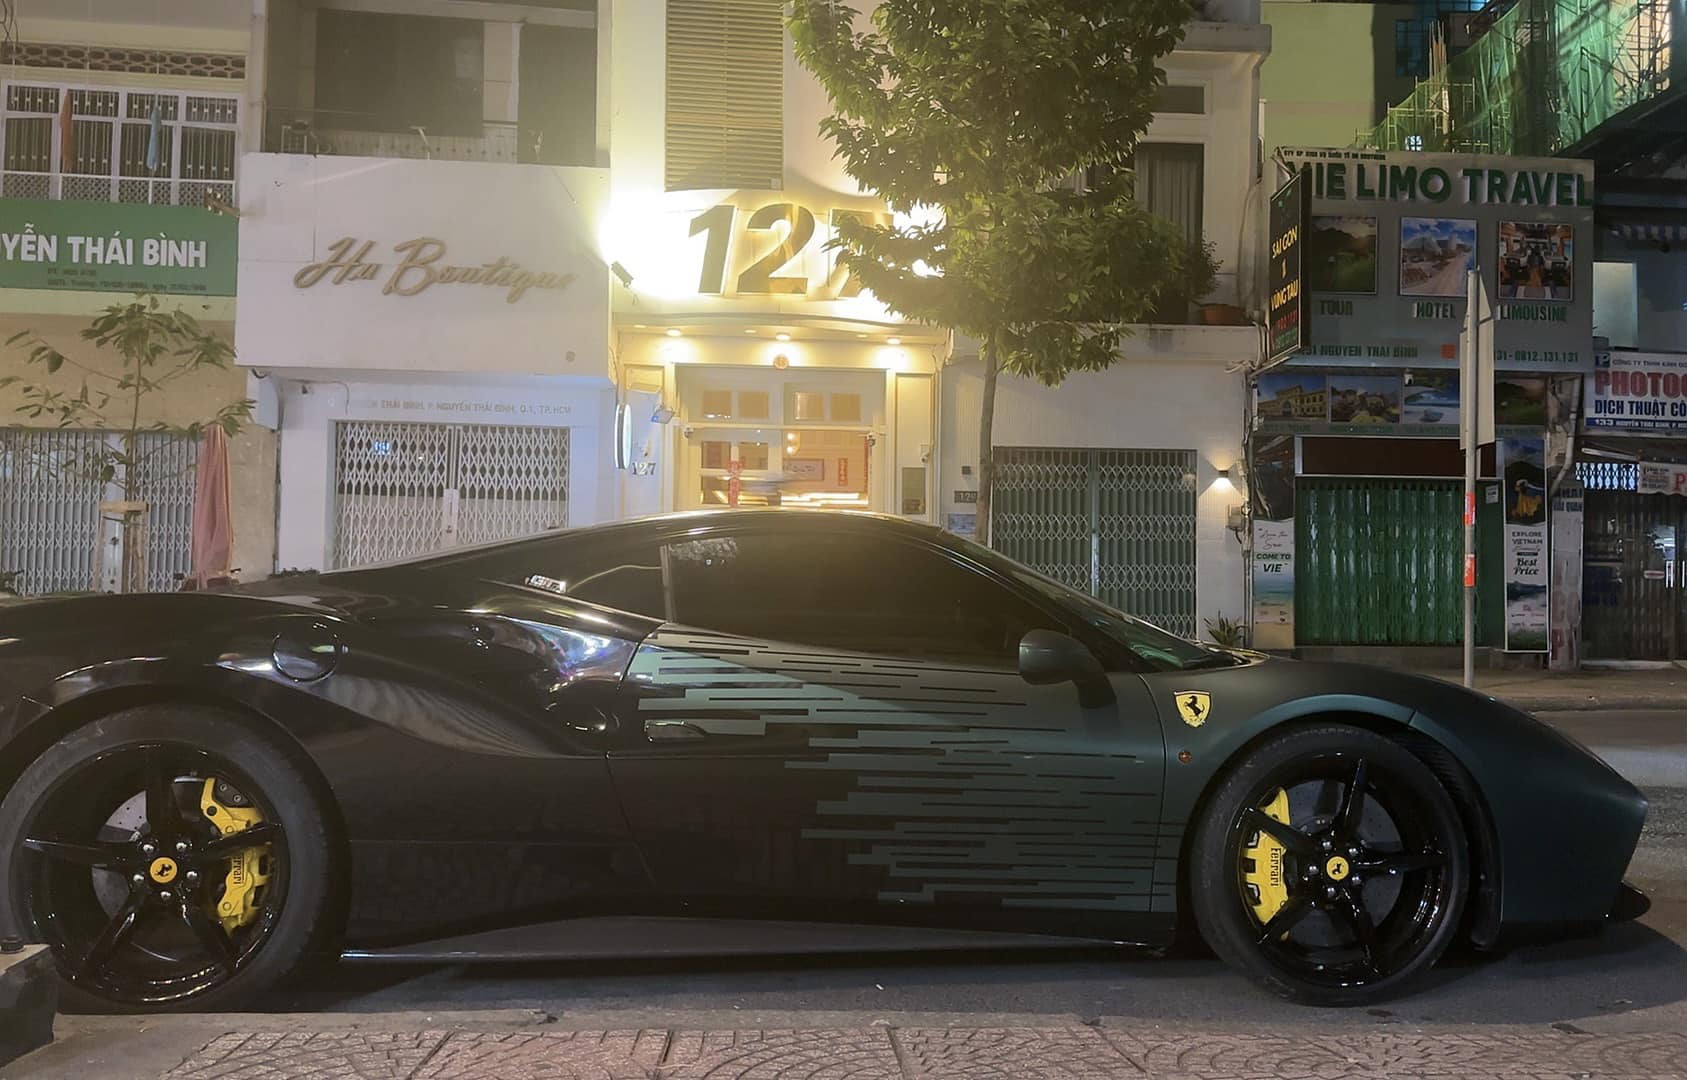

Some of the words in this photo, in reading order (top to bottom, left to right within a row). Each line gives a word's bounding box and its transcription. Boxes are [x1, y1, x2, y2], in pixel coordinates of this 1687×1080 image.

[1356, 163, 1453, 201] LIMO
[1462, 167, 1593, 208] TRAVEL
[2, 223, 57, 262] YỄN
[67, 231, 133, 265] THÁI
[143, 232, 206, 268] BÌNH
[1320, 301, 1352, 316] TOUR
[1416, 302, 1456, 318] HOTEL
[1499, 304, 1567, 321] LIMOUSINE
[1594, 399, 1624, 416] DỊCH
[1628, 399, 1667, 418] THUẬT
[1263, 563, 1283, 573] VIE
[1517, 557, 1538, 566] Best
[1513, 566, 1539, 575] Price
